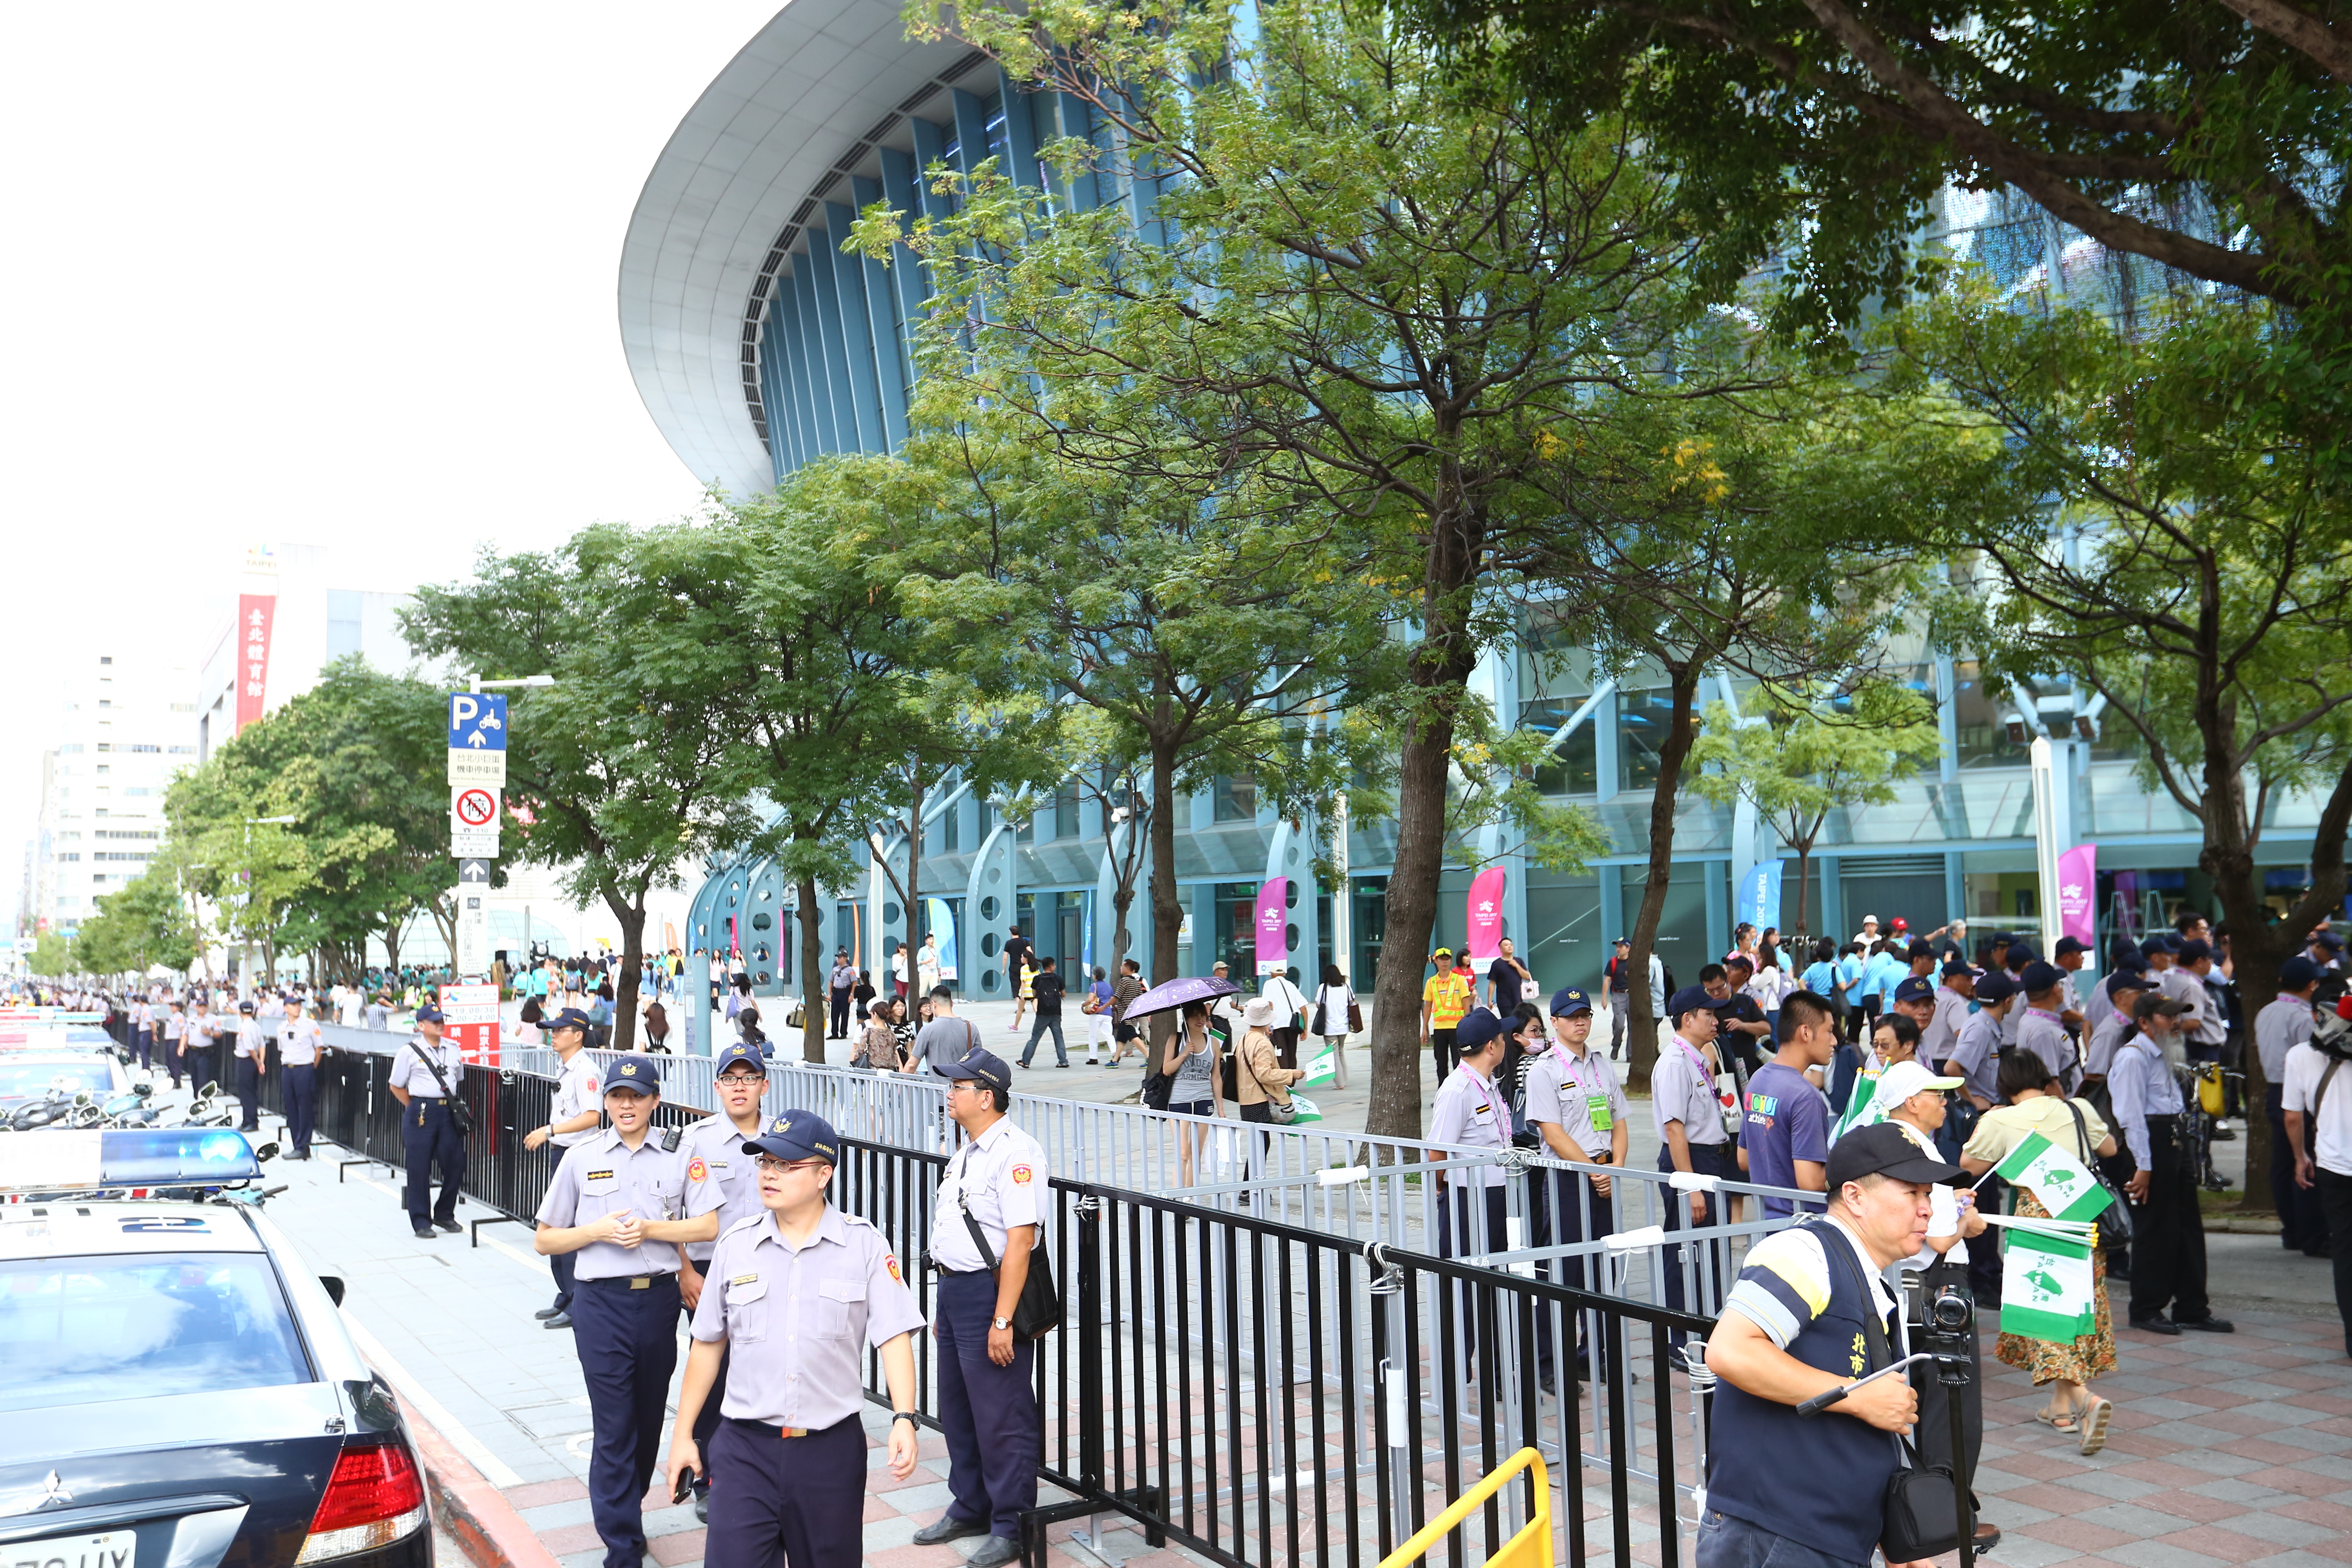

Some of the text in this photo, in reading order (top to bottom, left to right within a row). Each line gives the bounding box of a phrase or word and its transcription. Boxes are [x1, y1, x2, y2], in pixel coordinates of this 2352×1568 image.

[246, 559, 276, 569] TAIPEI
[247, 608, 265, 698] 臺北體育館
[453, 695, 479, 731] P
[457, 753, 499, 764] 台北小巨蛋
[457, 765, 499, 775] 機車停車場
[1757, 872, 1767, 928] TAIPEI 2017
[1184, 1058, 1212, 1069] UNDER
[2032, 1254, 2045, 1302] TAIWAN
